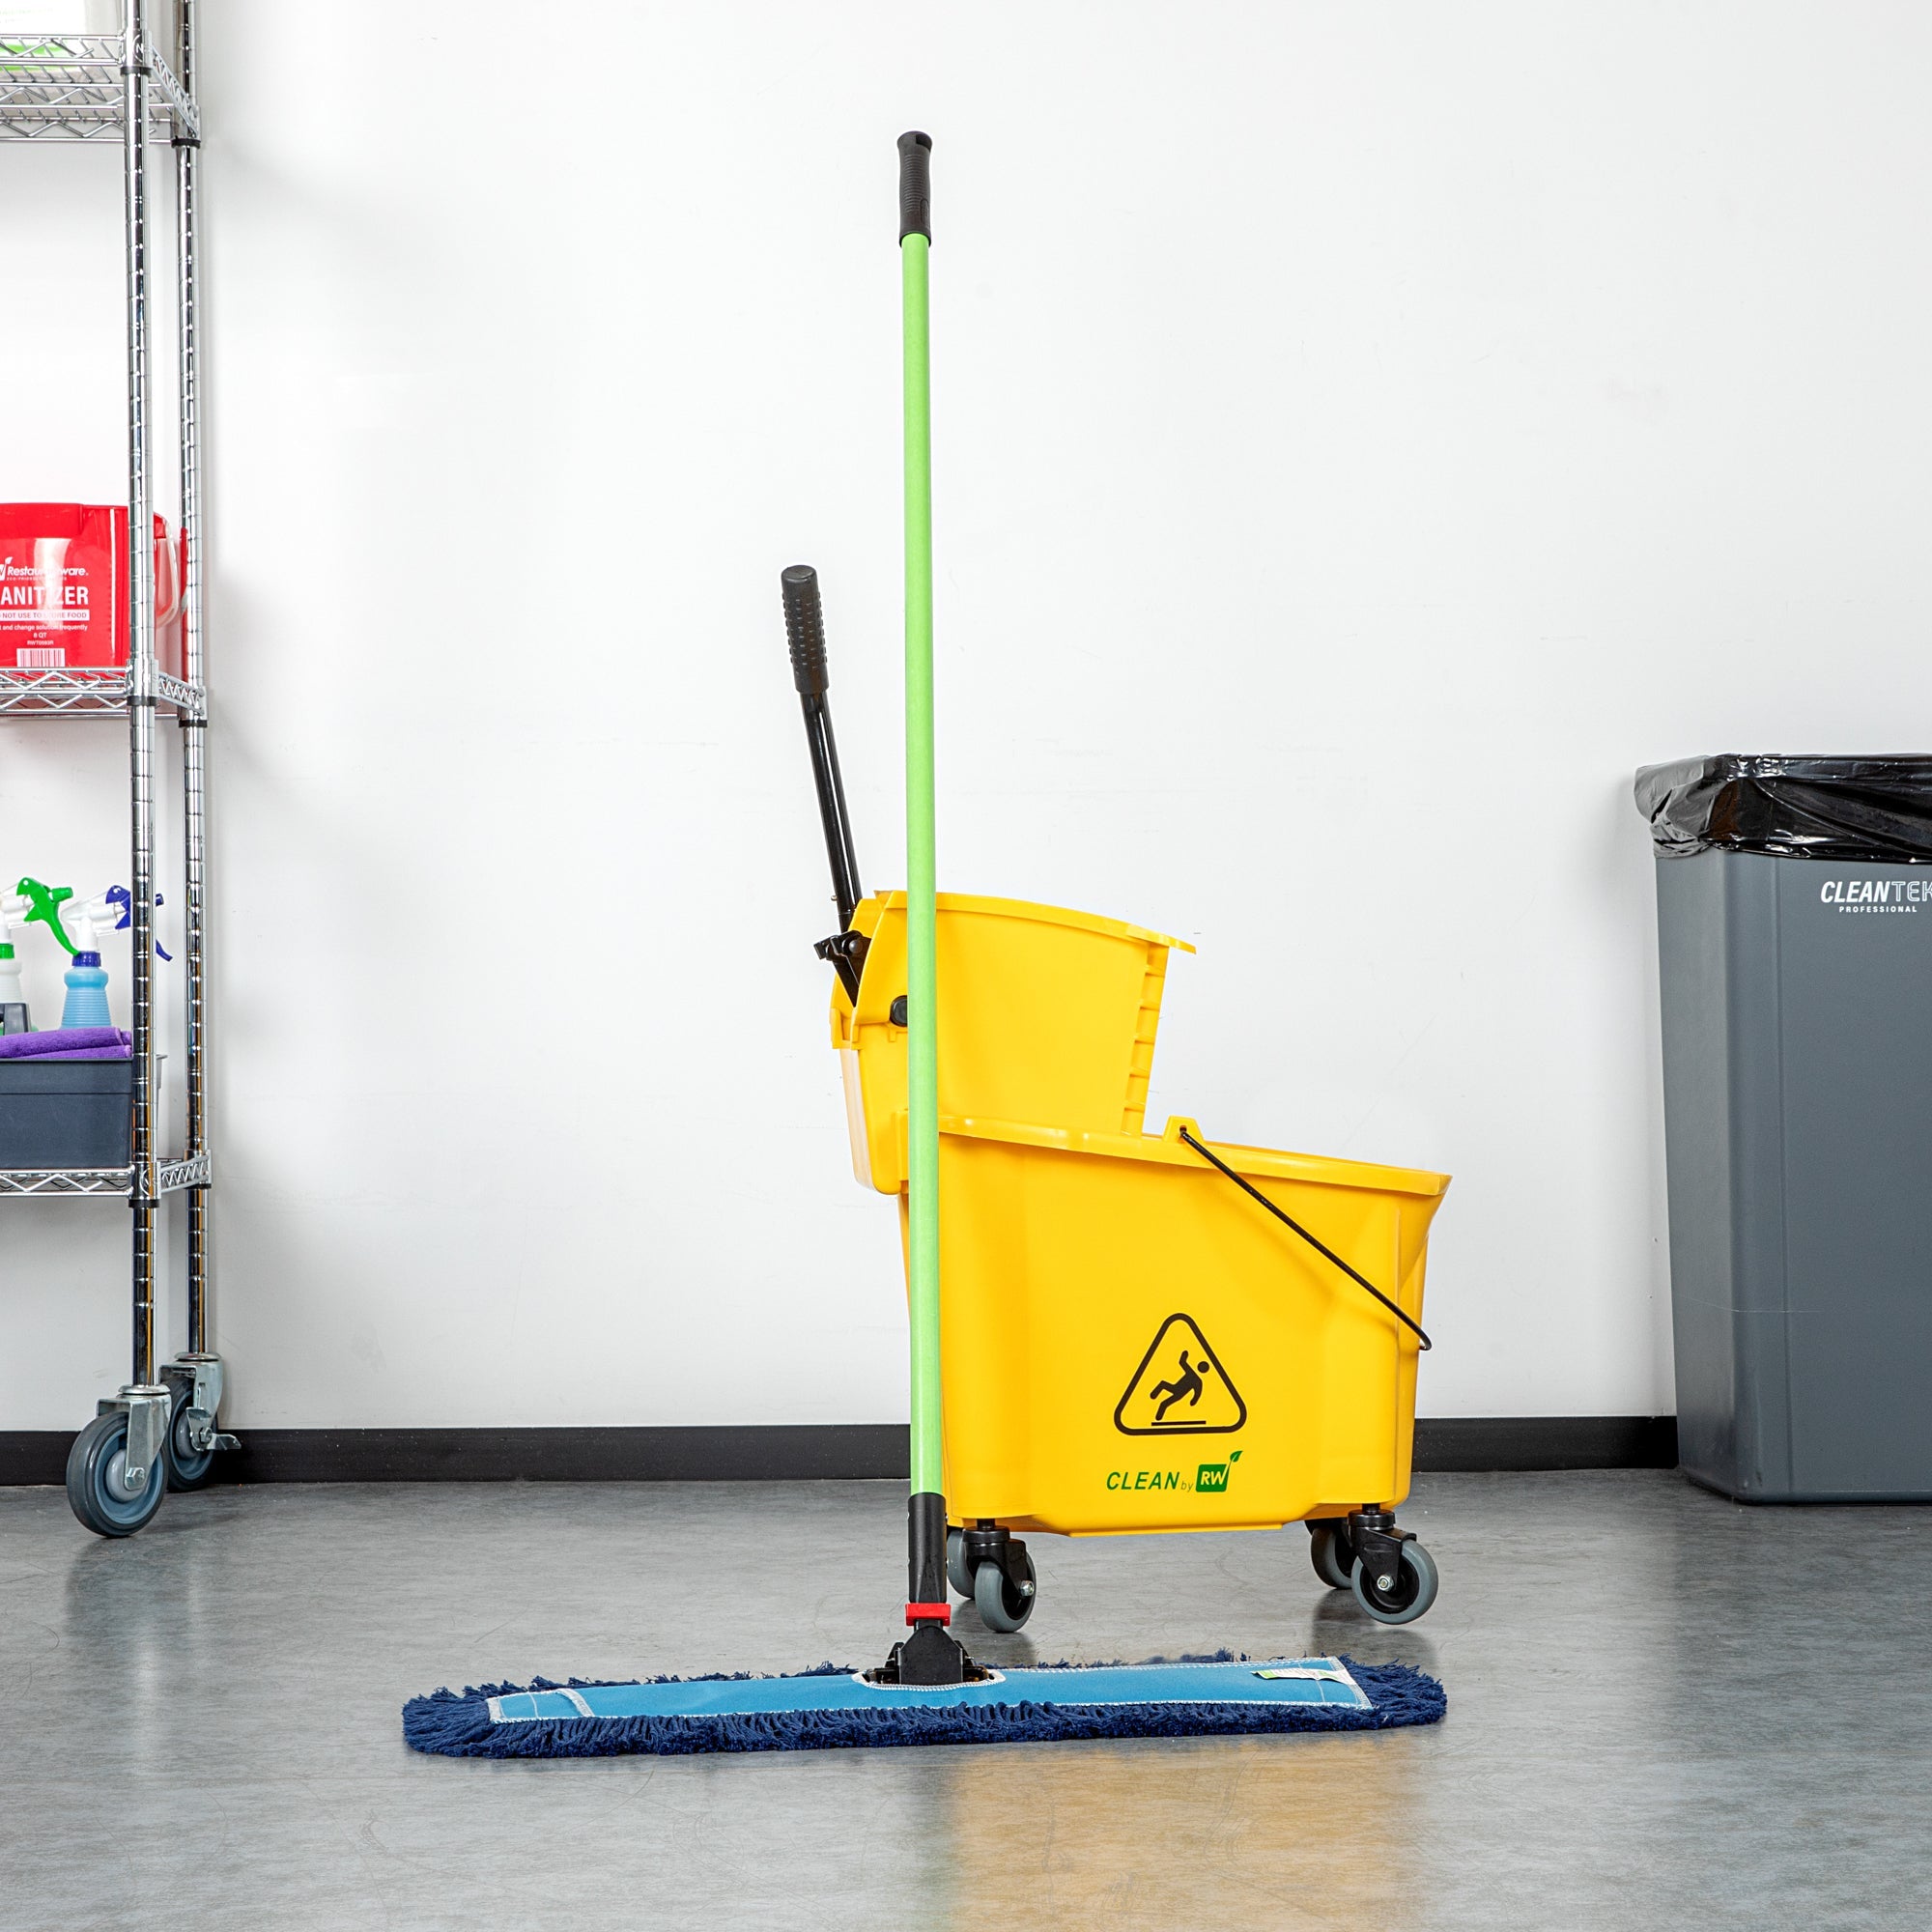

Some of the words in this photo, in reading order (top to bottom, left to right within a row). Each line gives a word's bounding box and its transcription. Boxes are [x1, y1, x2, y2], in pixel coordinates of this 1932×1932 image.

[1, 586, 89, 605] ANITZER
[1106, 1471, 1179, 1490] CLEAN
[1180, 1480, 1194, 1492] by
[1200, 1470, 1226, 1486] RW
